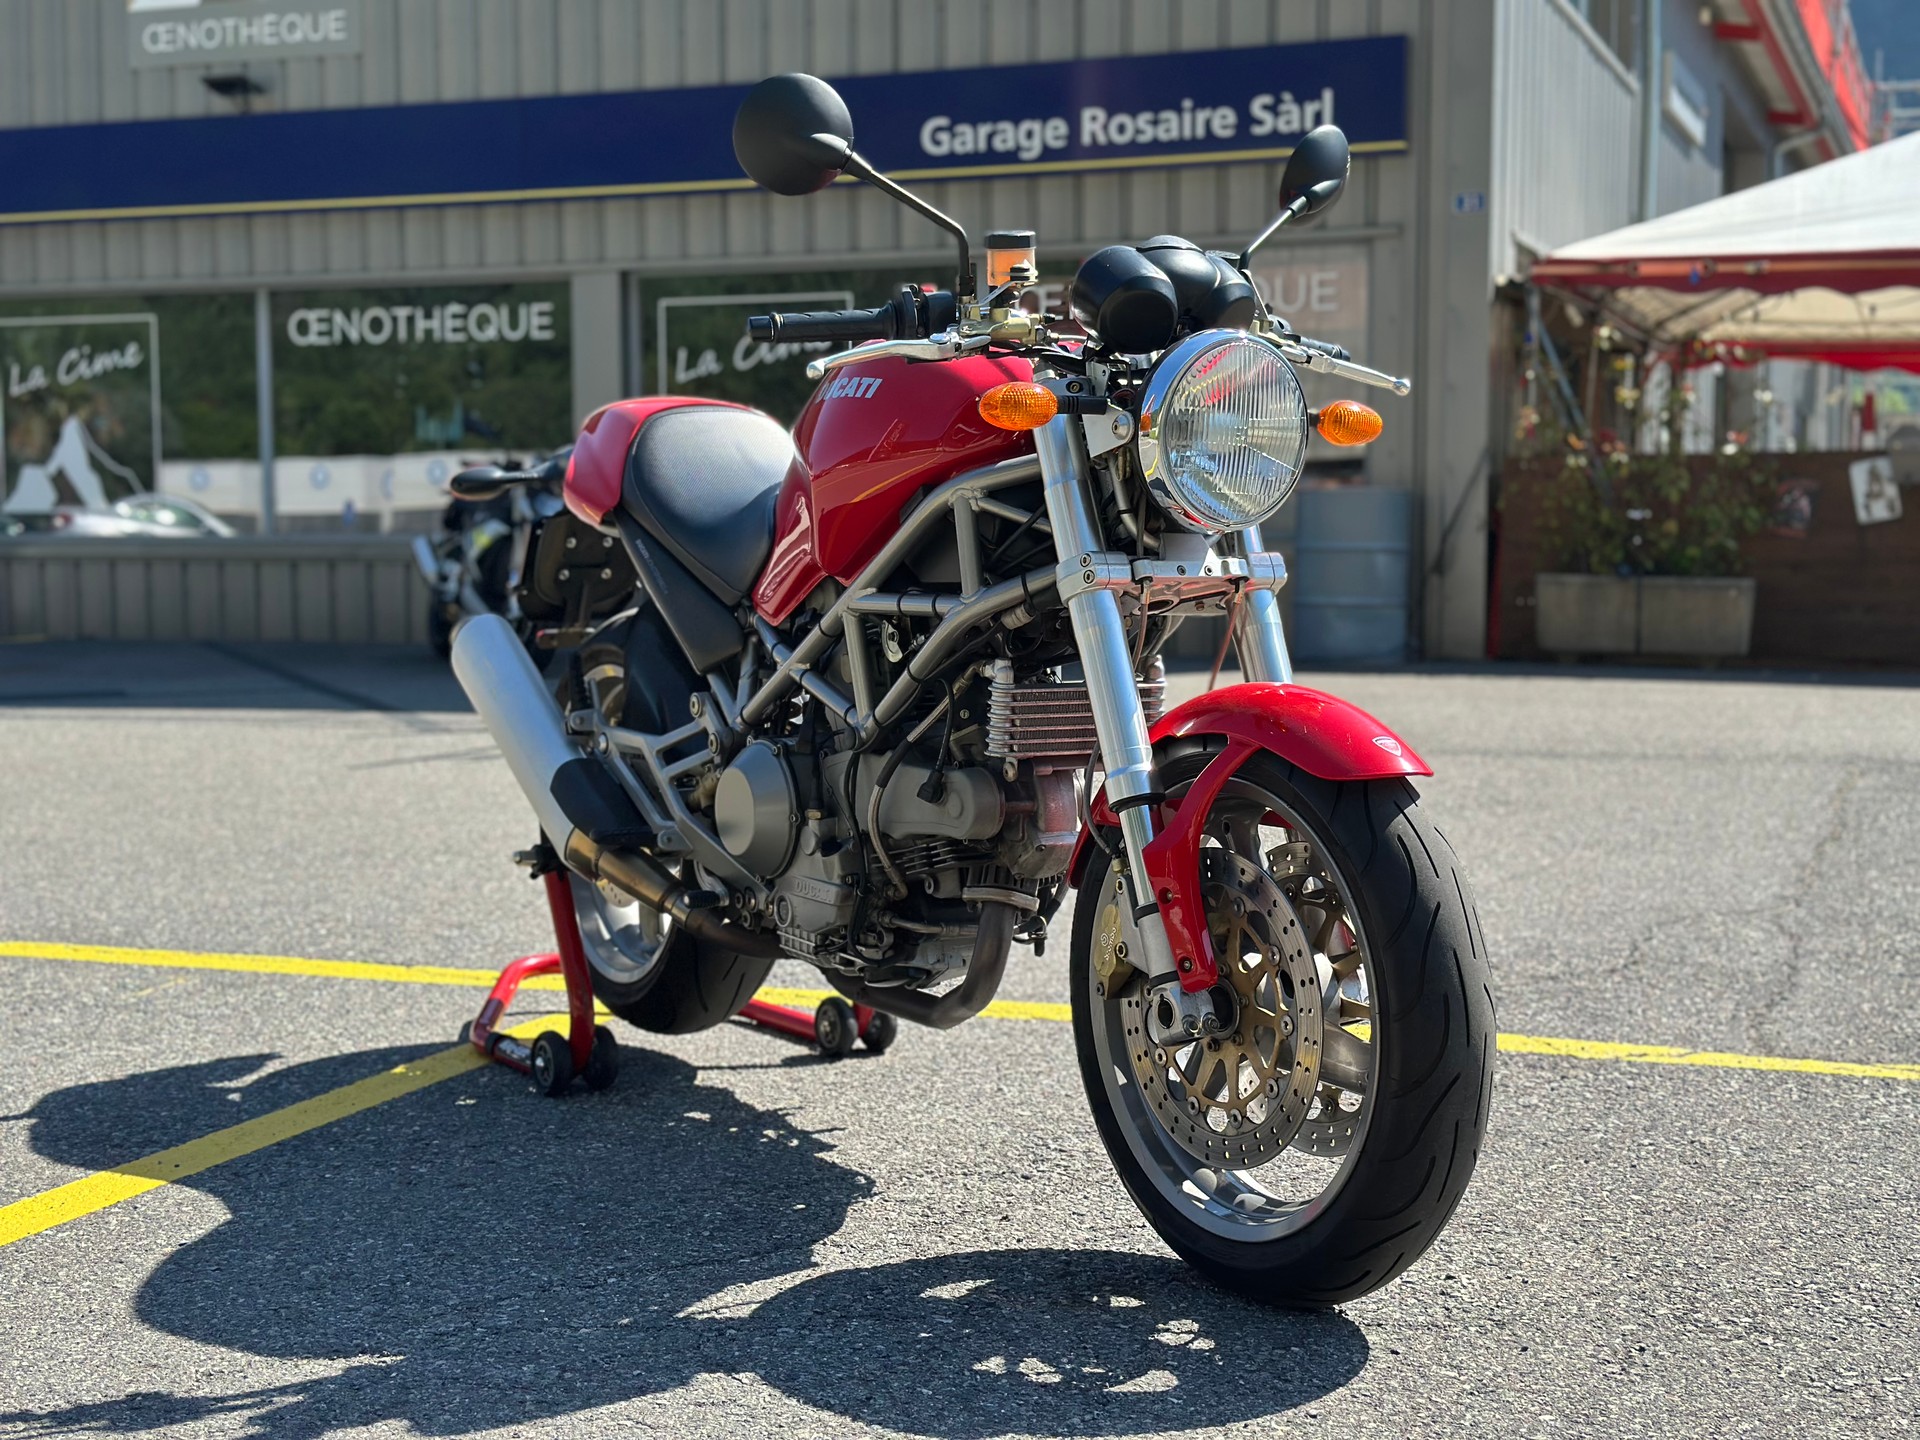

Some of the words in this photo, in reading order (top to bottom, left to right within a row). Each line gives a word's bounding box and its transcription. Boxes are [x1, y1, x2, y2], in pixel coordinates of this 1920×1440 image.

[920, 115, 1070, 161] Garage
[1080, 98, 1239, 146] Rosaire
[1249, 87, 1334, 136] Sàrl
[287, 301, 555, 346] ŒNOTHÈQUE
[9, 361, 50, 398] La
[57, 341, 144, 386] Cime
[675, 345, 724, 384] La
